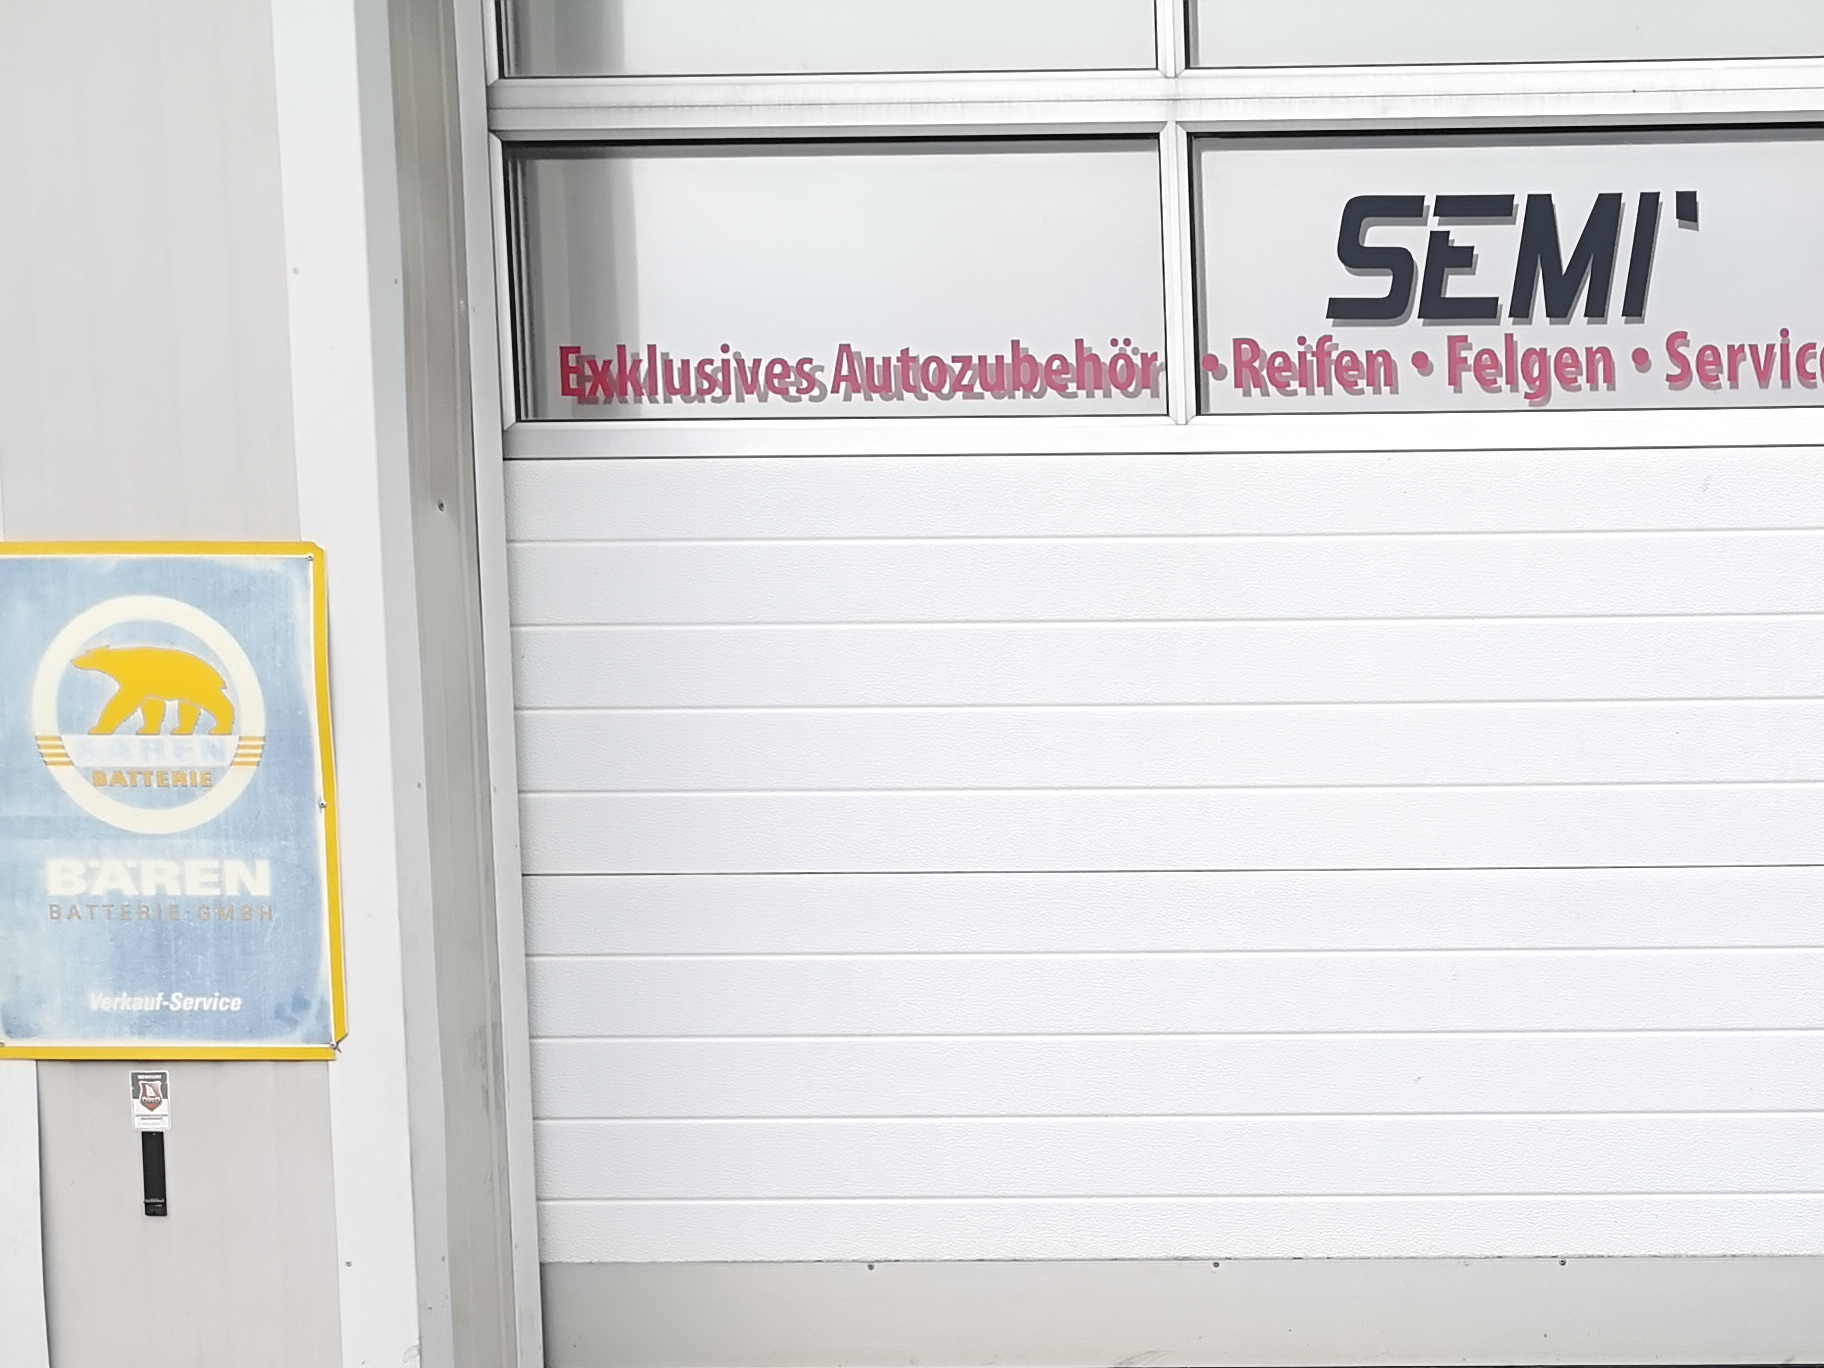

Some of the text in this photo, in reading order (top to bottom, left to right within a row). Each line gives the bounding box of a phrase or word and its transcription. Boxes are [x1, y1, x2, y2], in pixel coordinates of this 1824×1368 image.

[560, 344, 816, 398] Exklusives
[831, 337, 1160, 395] Autozubehör
[1232, 334, 1394, 389] Reifen
[1447, 333, 1613, 400] Felgen
[92, 770, 213, 787] BATTERIE
[48, 859, 271, 896] BÄREN
[49, 903, 273, 922] BATTERIE GMBH
[88, 991, 243, 1012] Verkauf-Service
